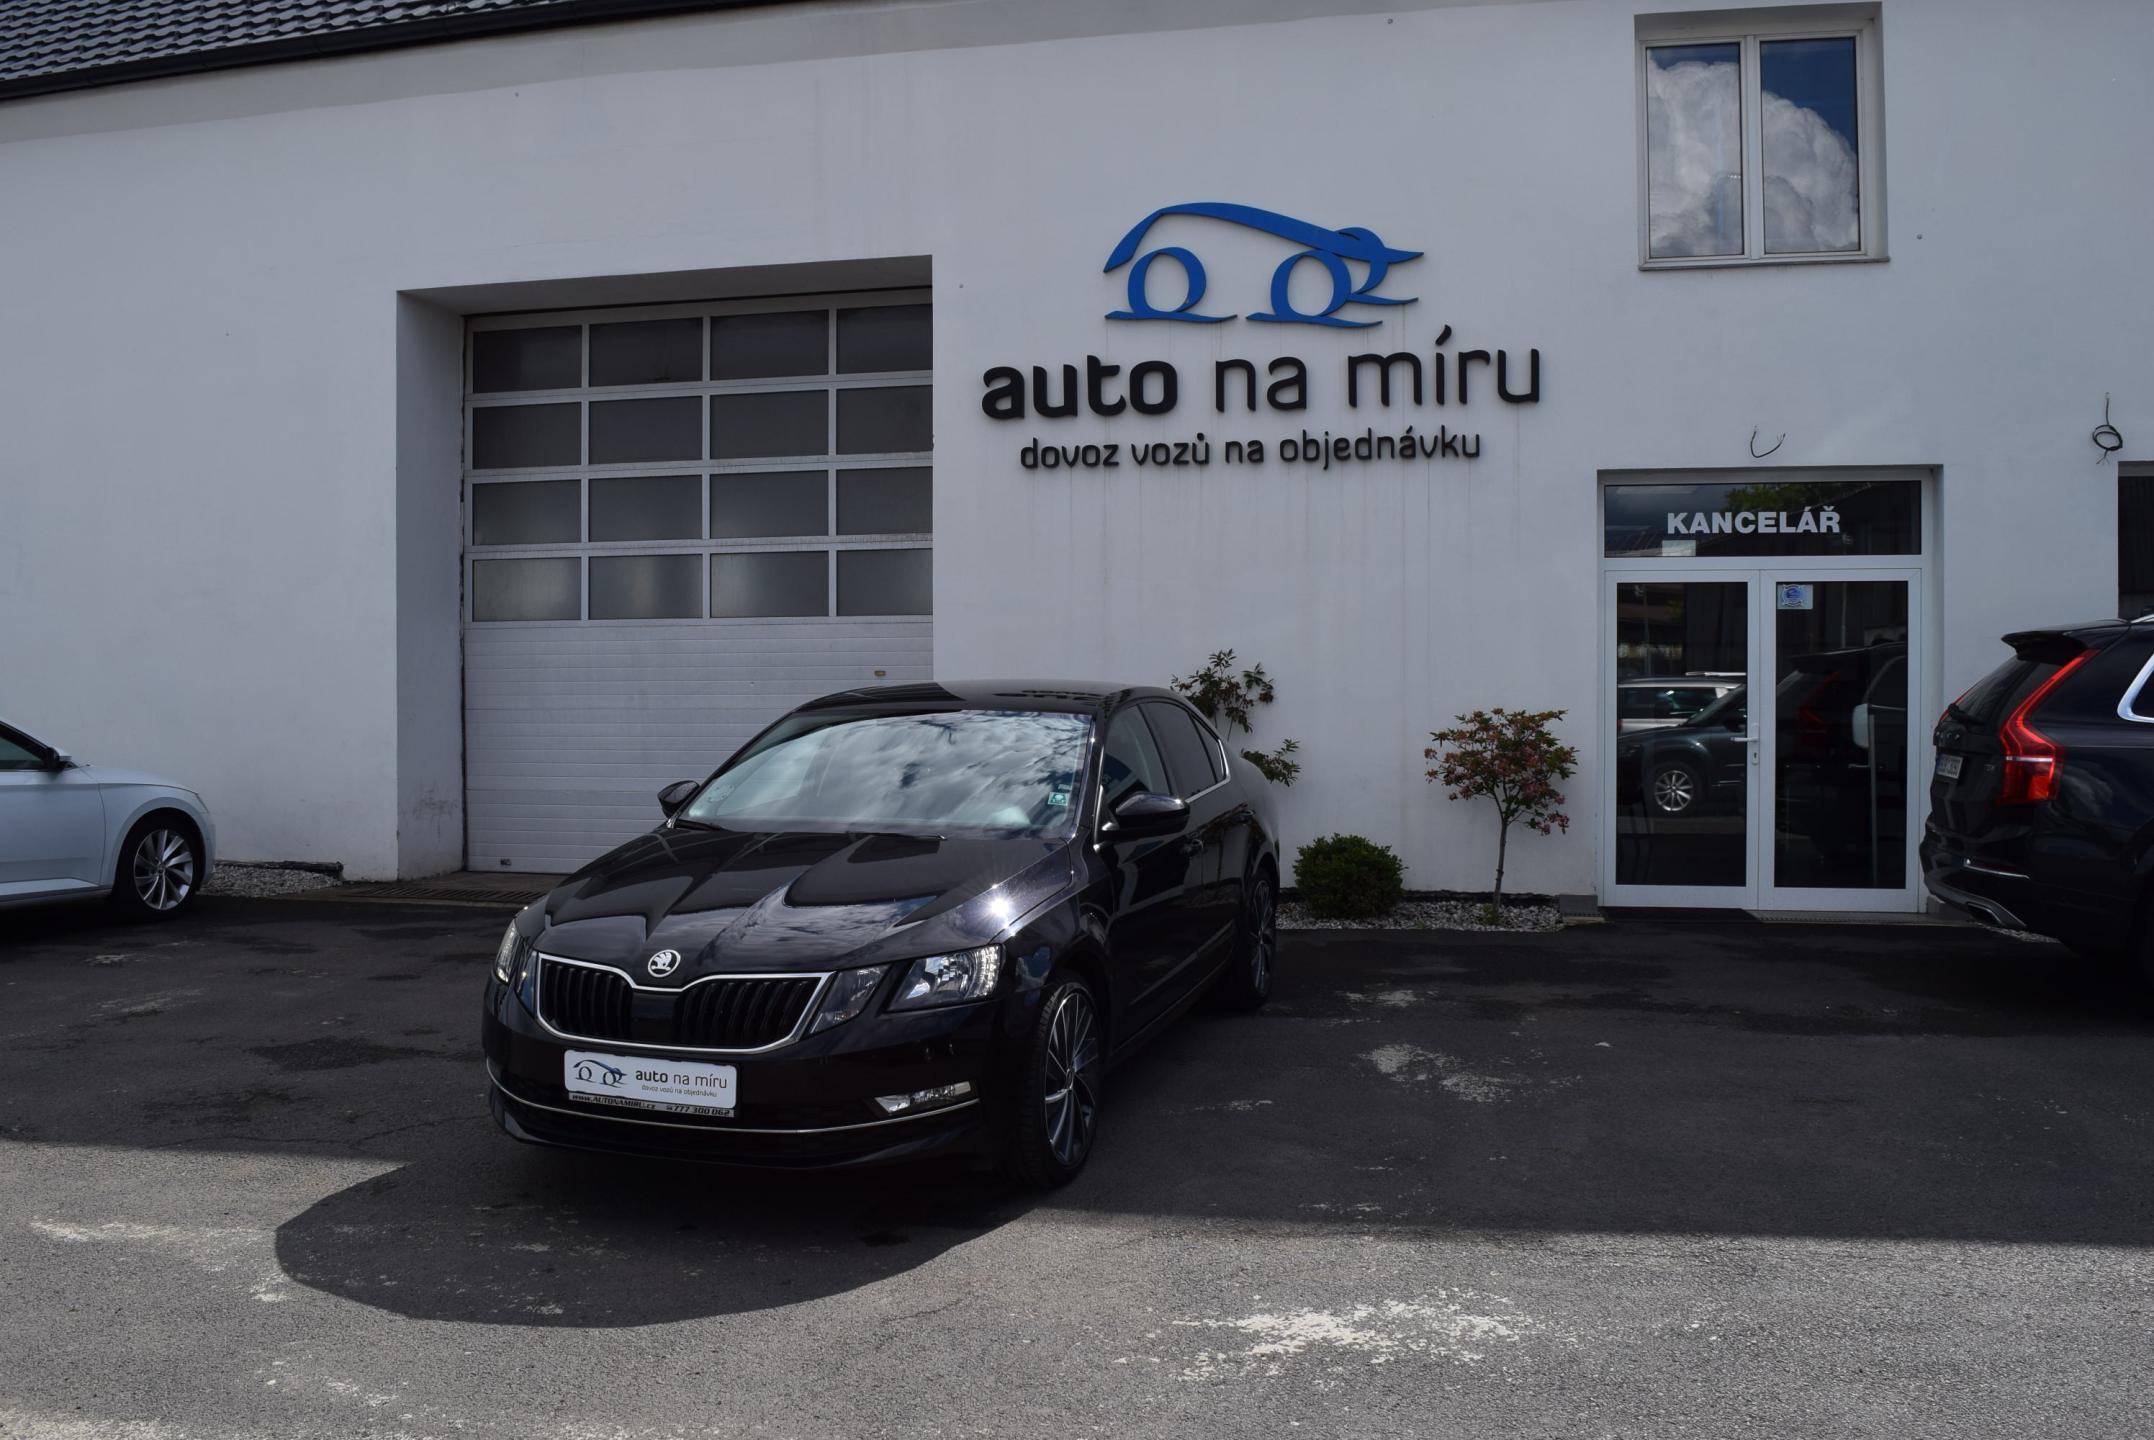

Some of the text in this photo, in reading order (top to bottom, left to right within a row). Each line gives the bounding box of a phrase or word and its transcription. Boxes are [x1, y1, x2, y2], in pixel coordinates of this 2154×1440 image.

[981, 325, 1541, 420] auto na míru
[1020, 425, 1481, 471] dovoz vozů na objednávku
[1667, 506, 1841, 535] KANCELÁŘ
[635, 1069, 728, 1089] auto na míru
